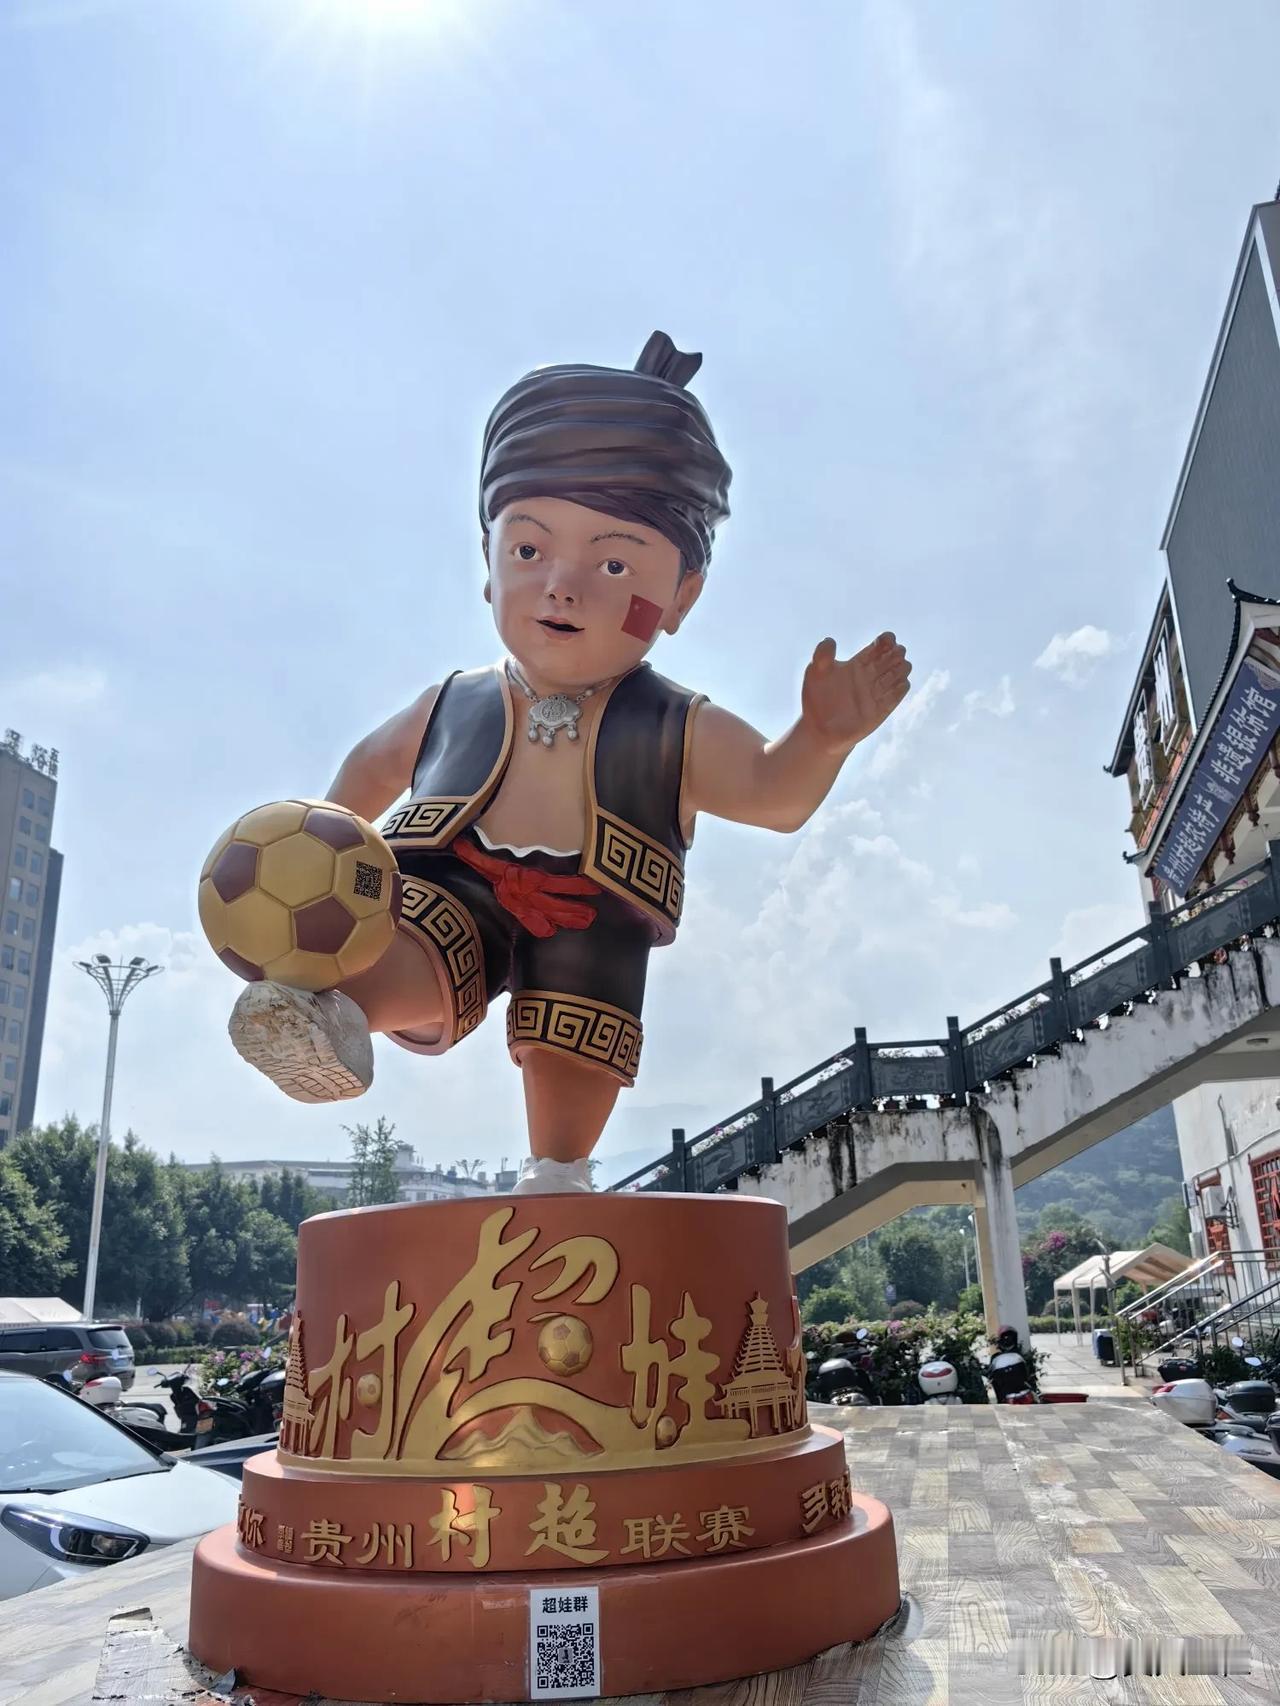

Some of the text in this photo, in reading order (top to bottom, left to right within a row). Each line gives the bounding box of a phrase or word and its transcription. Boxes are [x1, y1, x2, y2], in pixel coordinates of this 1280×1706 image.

[1210, 686, 1278, 786] 非遗银饰馆
[301, 1482, 756, 1568] 贵州村超联赛
[542, 1595, 589, 1614] 超娃群
